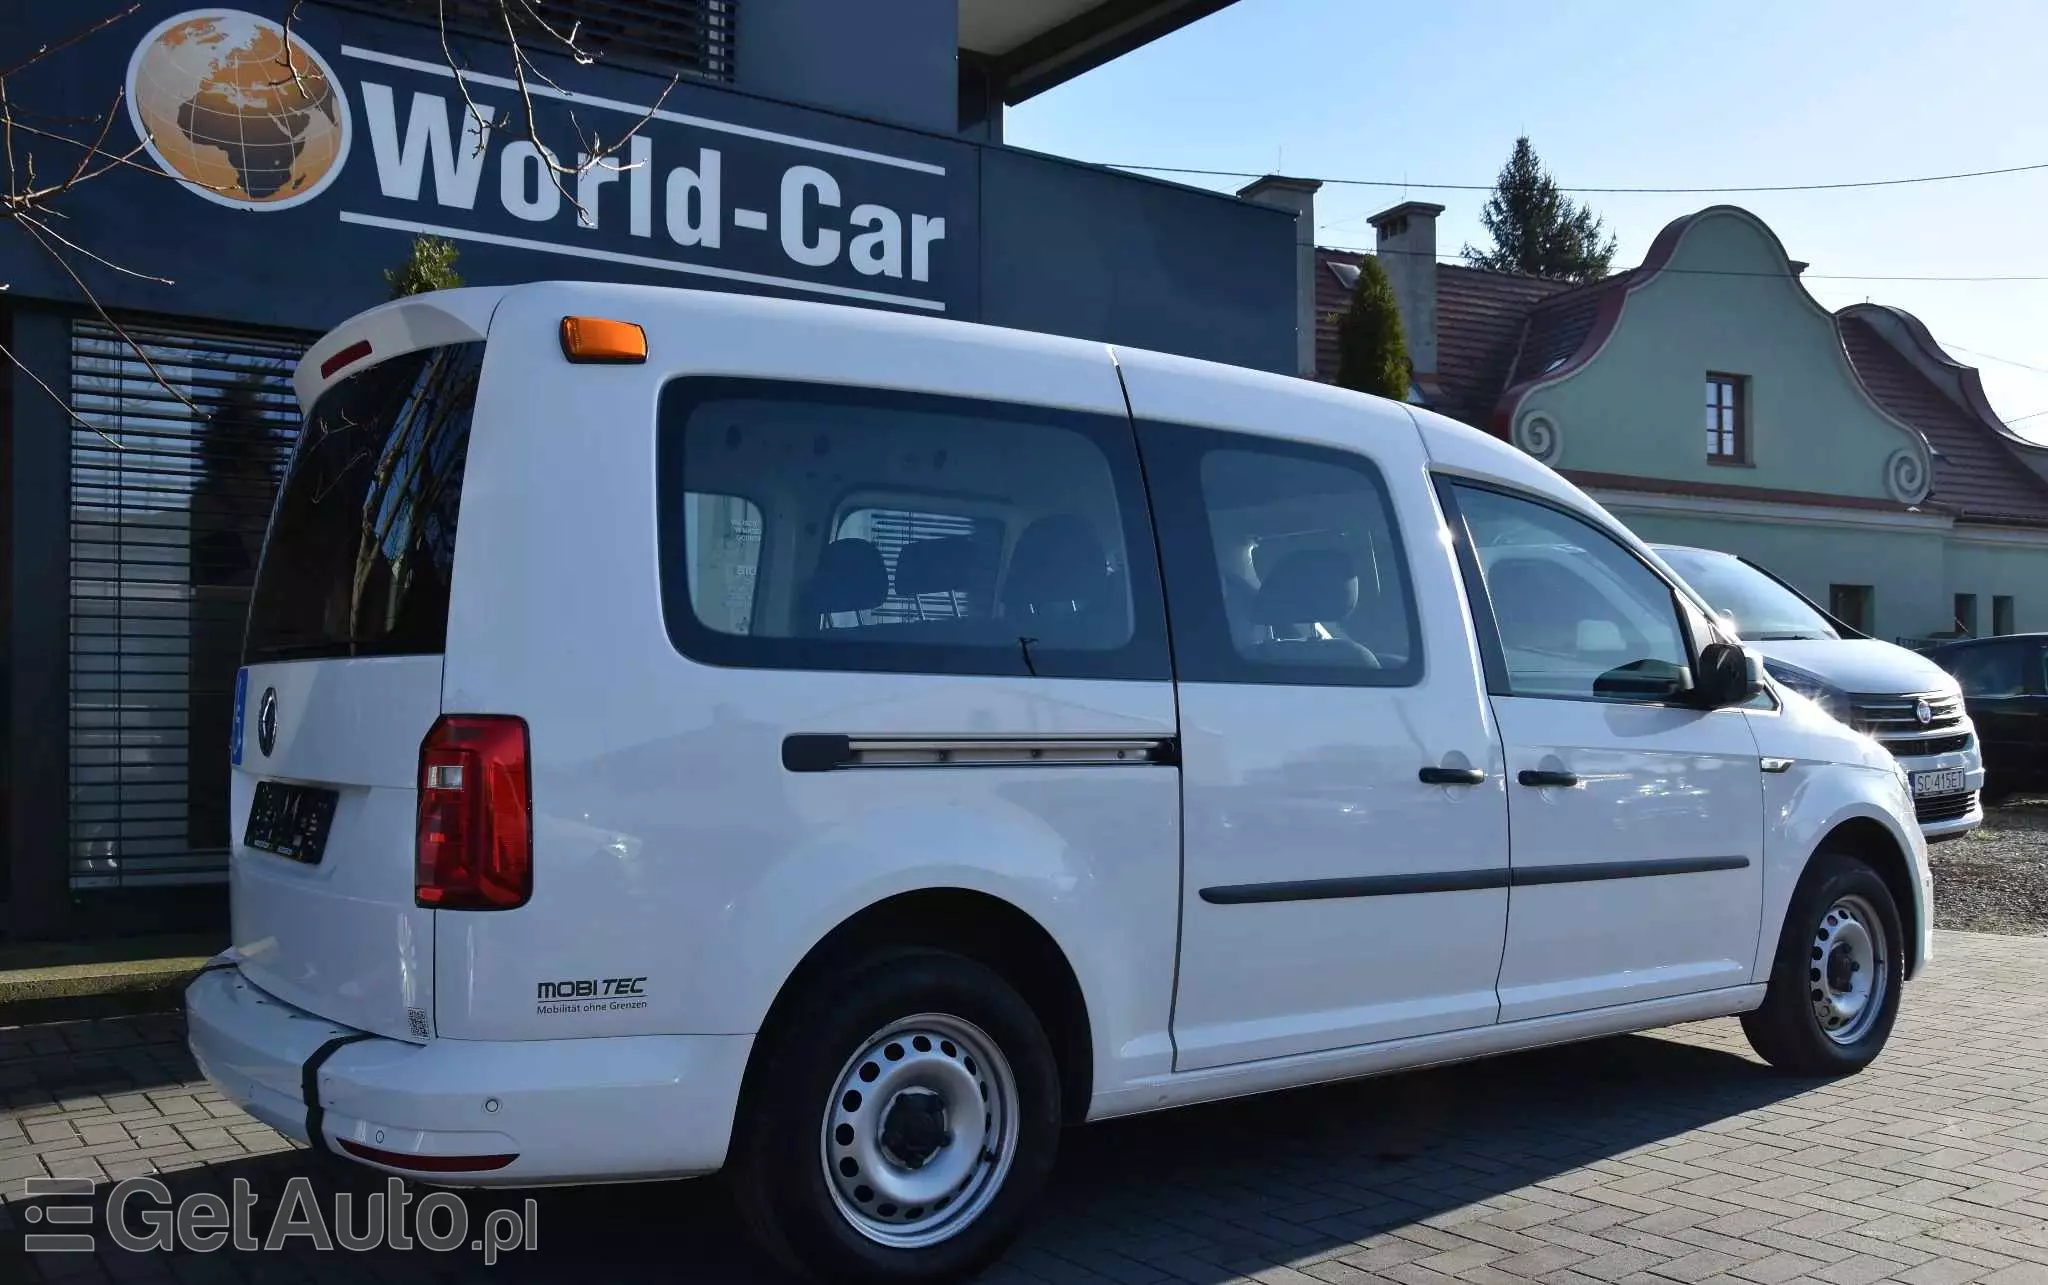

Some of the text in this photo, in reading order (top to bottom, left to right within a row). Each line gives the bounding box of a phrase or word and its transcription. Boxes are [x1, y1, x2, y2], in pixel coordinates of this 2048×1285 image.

[361, 81, 945, 282] World-Car
[536, 1001, 647, 1015] Mobilität ohne Grenzen
